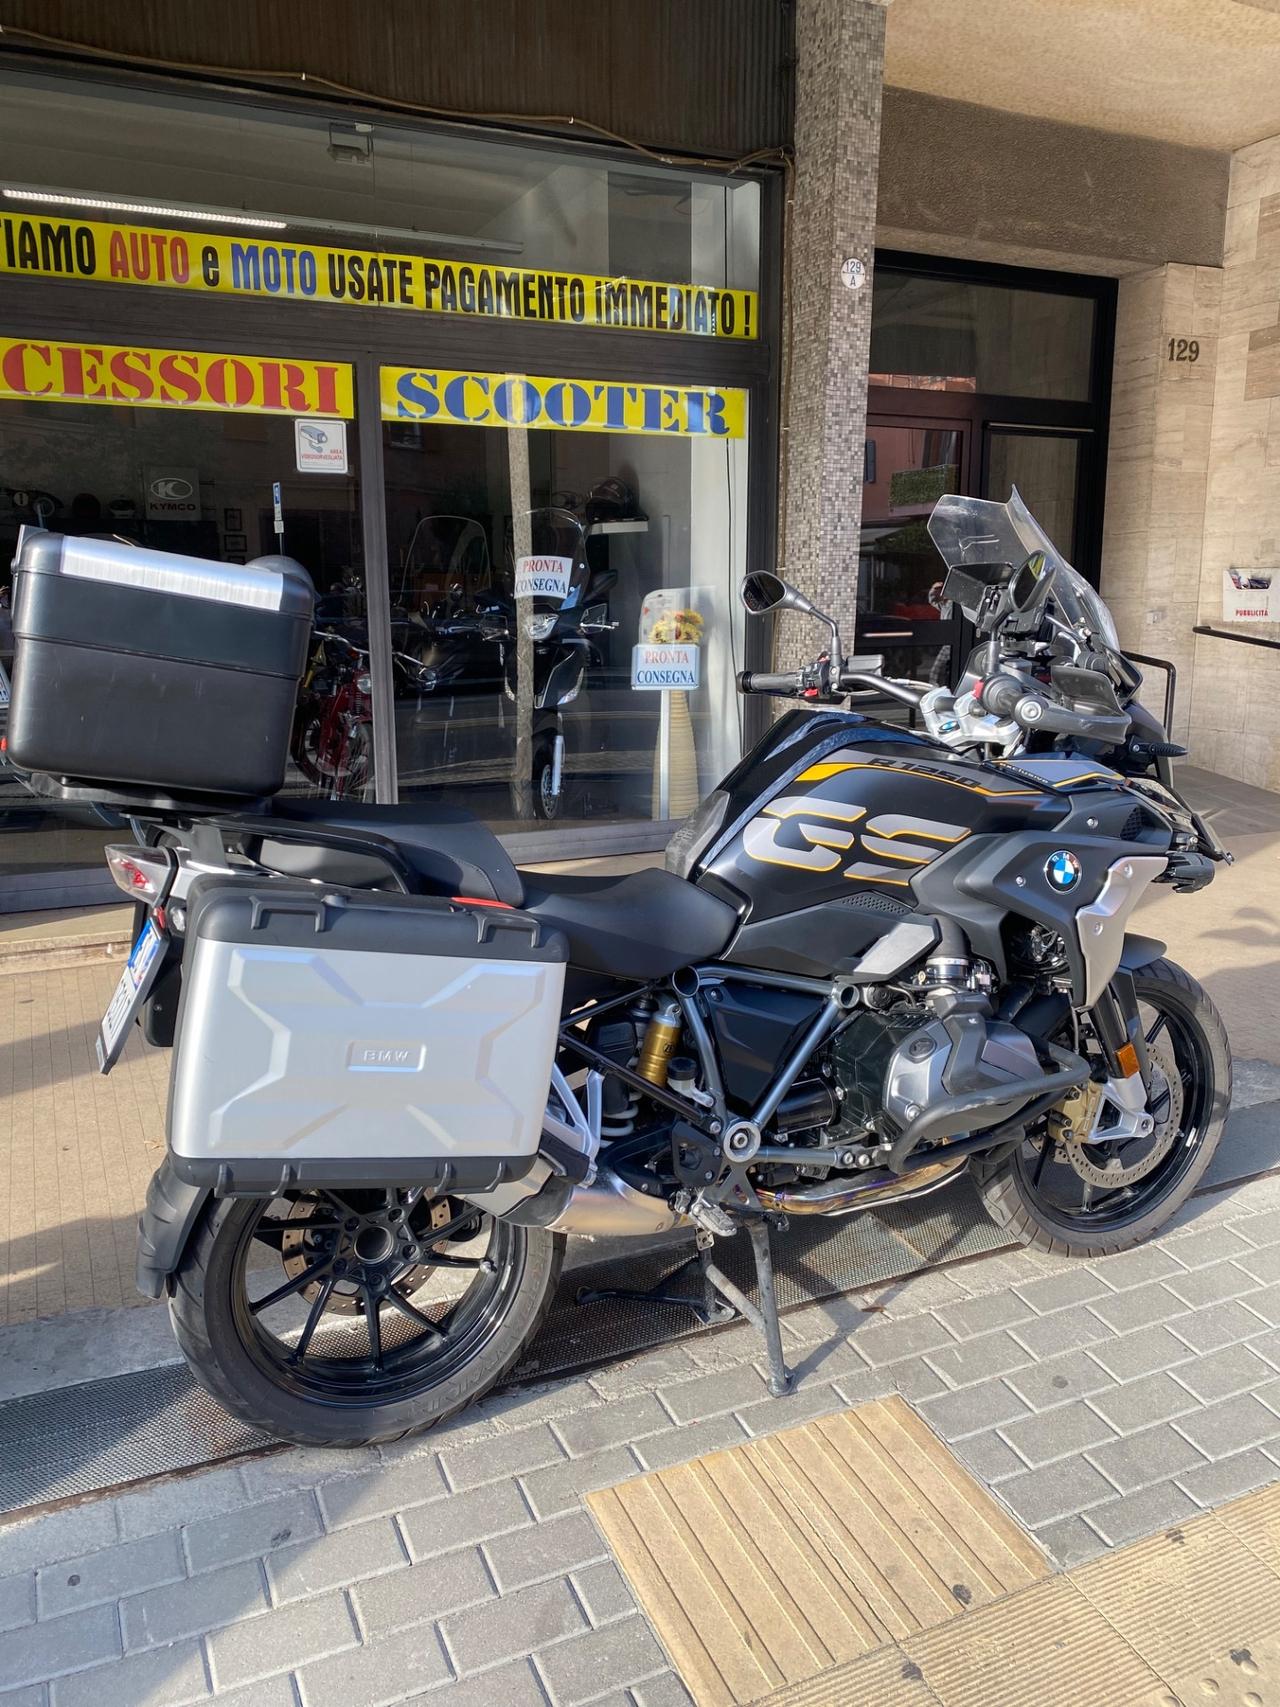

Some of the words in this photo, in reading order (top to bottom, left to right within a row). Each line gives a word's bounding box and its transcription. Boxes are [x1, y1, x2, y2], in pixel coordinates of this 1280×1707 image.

[0, 219, 96, 275] IAMO
[110, 230, 190, 284] AUTO
[202, 246, 219, 287] e
[230, 243, 317, 296] MOTO
[328, 253, 413, 304] USATE
[424, 263, 585, 323] PAGAMENTO
[846, 261, 861, 273] 129
[849, 275, 856, 286] A
[1168, 338, 1199, 362] 129
[2, 343, 341, 414] CESSORI
[396, 372, 730, 435] SCOOTER
[150, 503, 196, 511] KYMCO
[522, 560, 563, 573] PRONTA
[515, 578, 566, 594] CONSEGNA
[645, 651, 688, 664] PRONTA
[637, 670, 695, 683] CONSEGNA
[743, 796, 972, 886] GS
[1051, 852, 1079, 869] BMW
[362, 1048, 409, 1062] BMW
